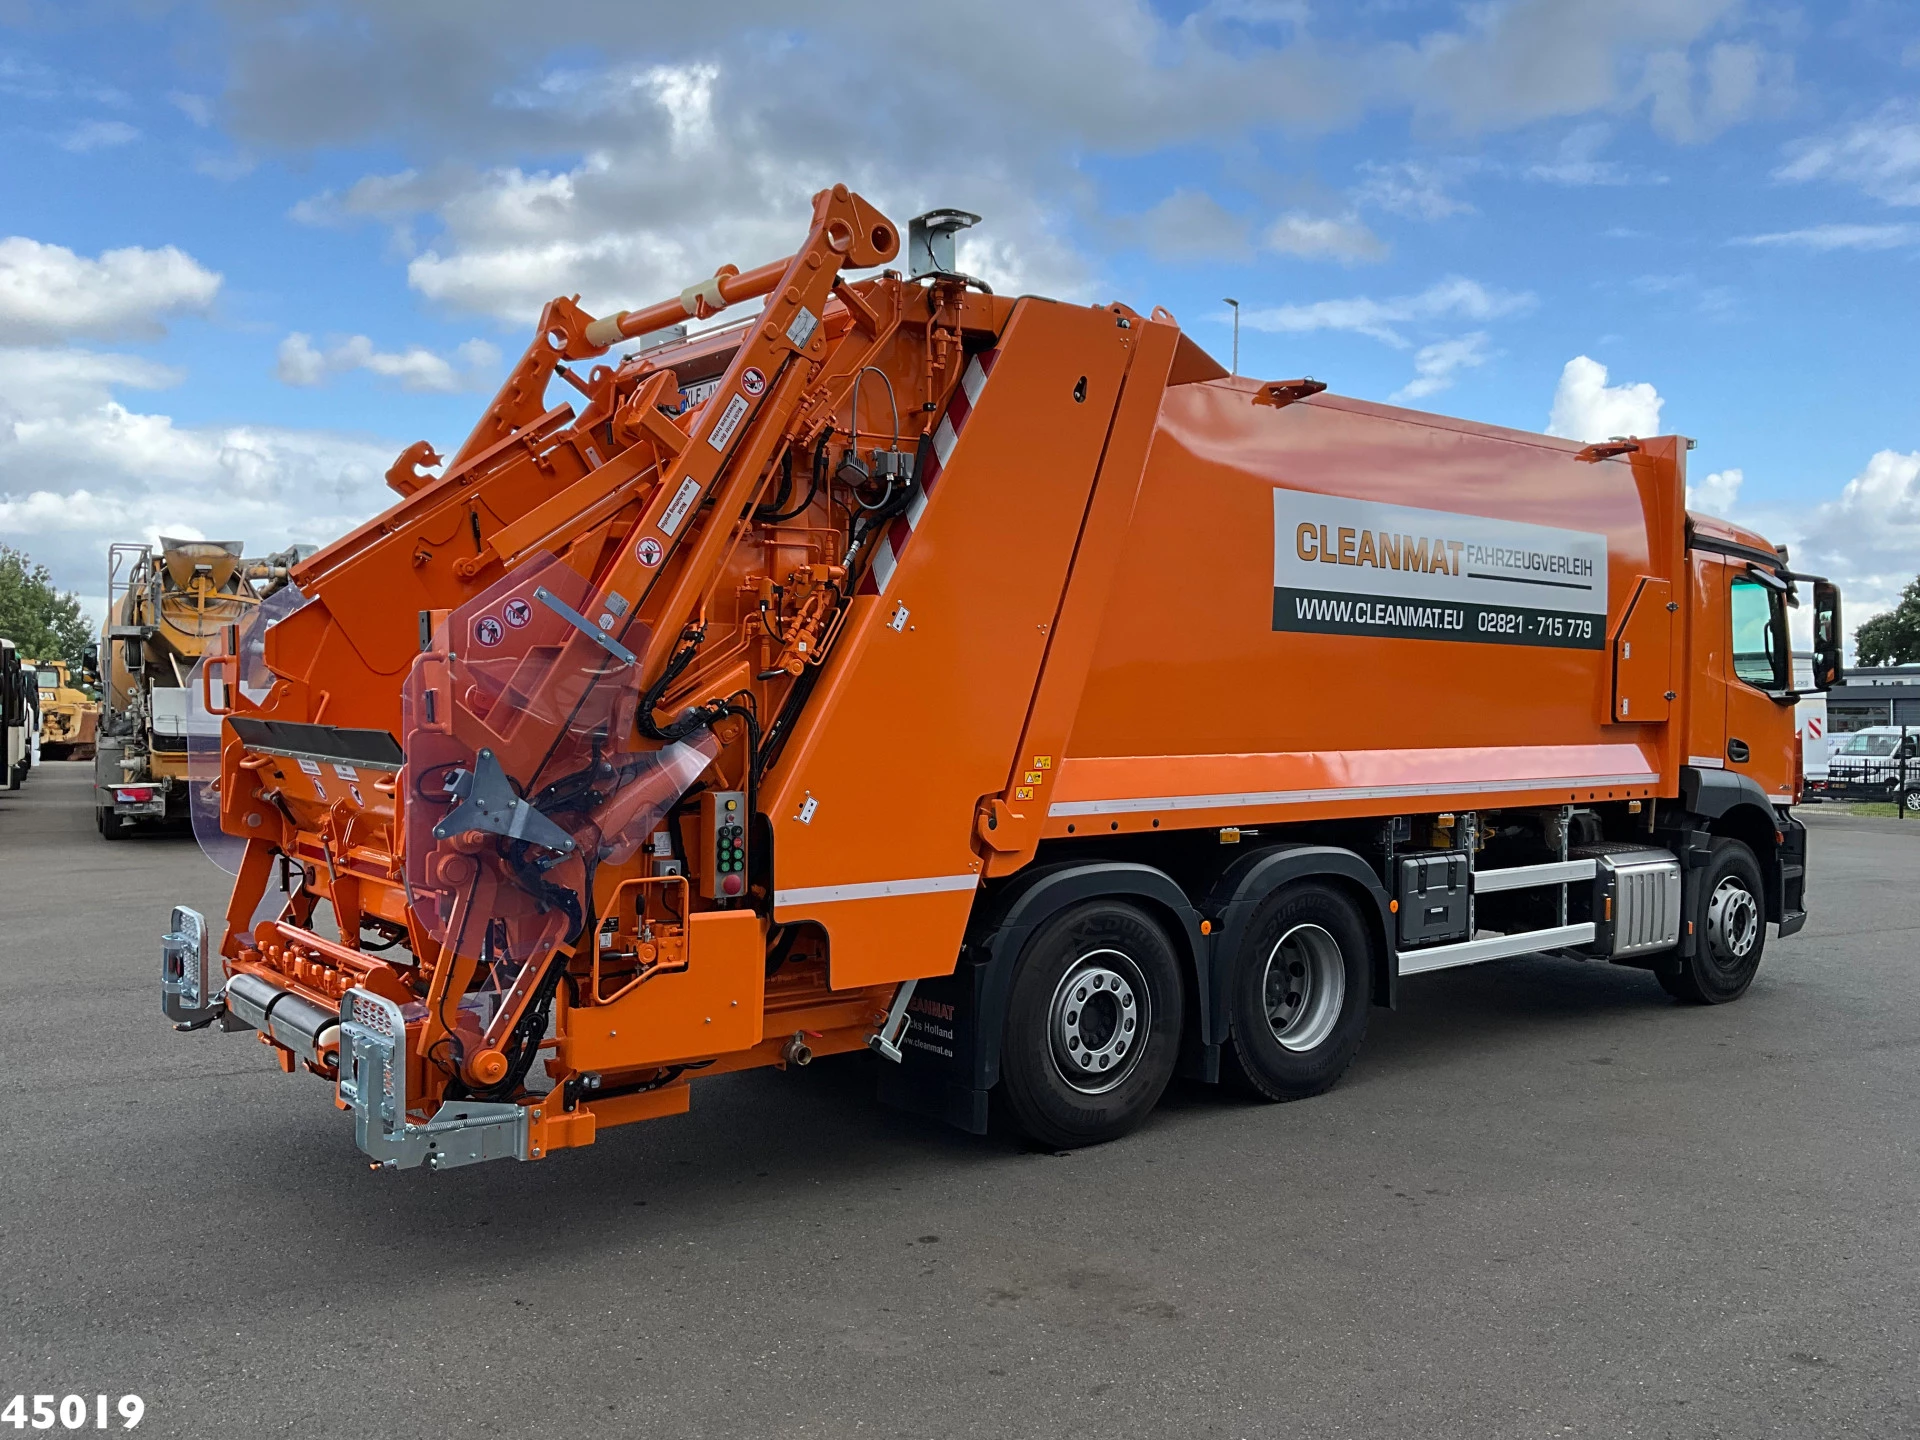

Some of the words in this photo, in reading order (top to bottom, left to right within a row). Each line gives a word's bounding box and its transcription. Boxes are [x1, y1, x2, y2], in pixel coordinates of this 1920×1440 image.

[686, 387, 701, 409] KLE
[733, 406, 743, 420] Nicht
[711, 426, 723, 441] treten
[725, 419, 736, 434] hinter
[719, 432, 727, 443] den
[677, 501, 688, 515] Nicht
[1296, 522, 1464, 576] CLEANMAT
[1467, 545, 1592, 577] FAHRZEUGVERLEIH
[1295, 597, 1464, 630] WWW.CLEANMAT.EU
[1477, 611, 1523, 634] 02821
[1537, 616, 1563, 637] 715
[1567, 619, 1592, 639] 779
[924, 1022, 953, 1040] Holland
